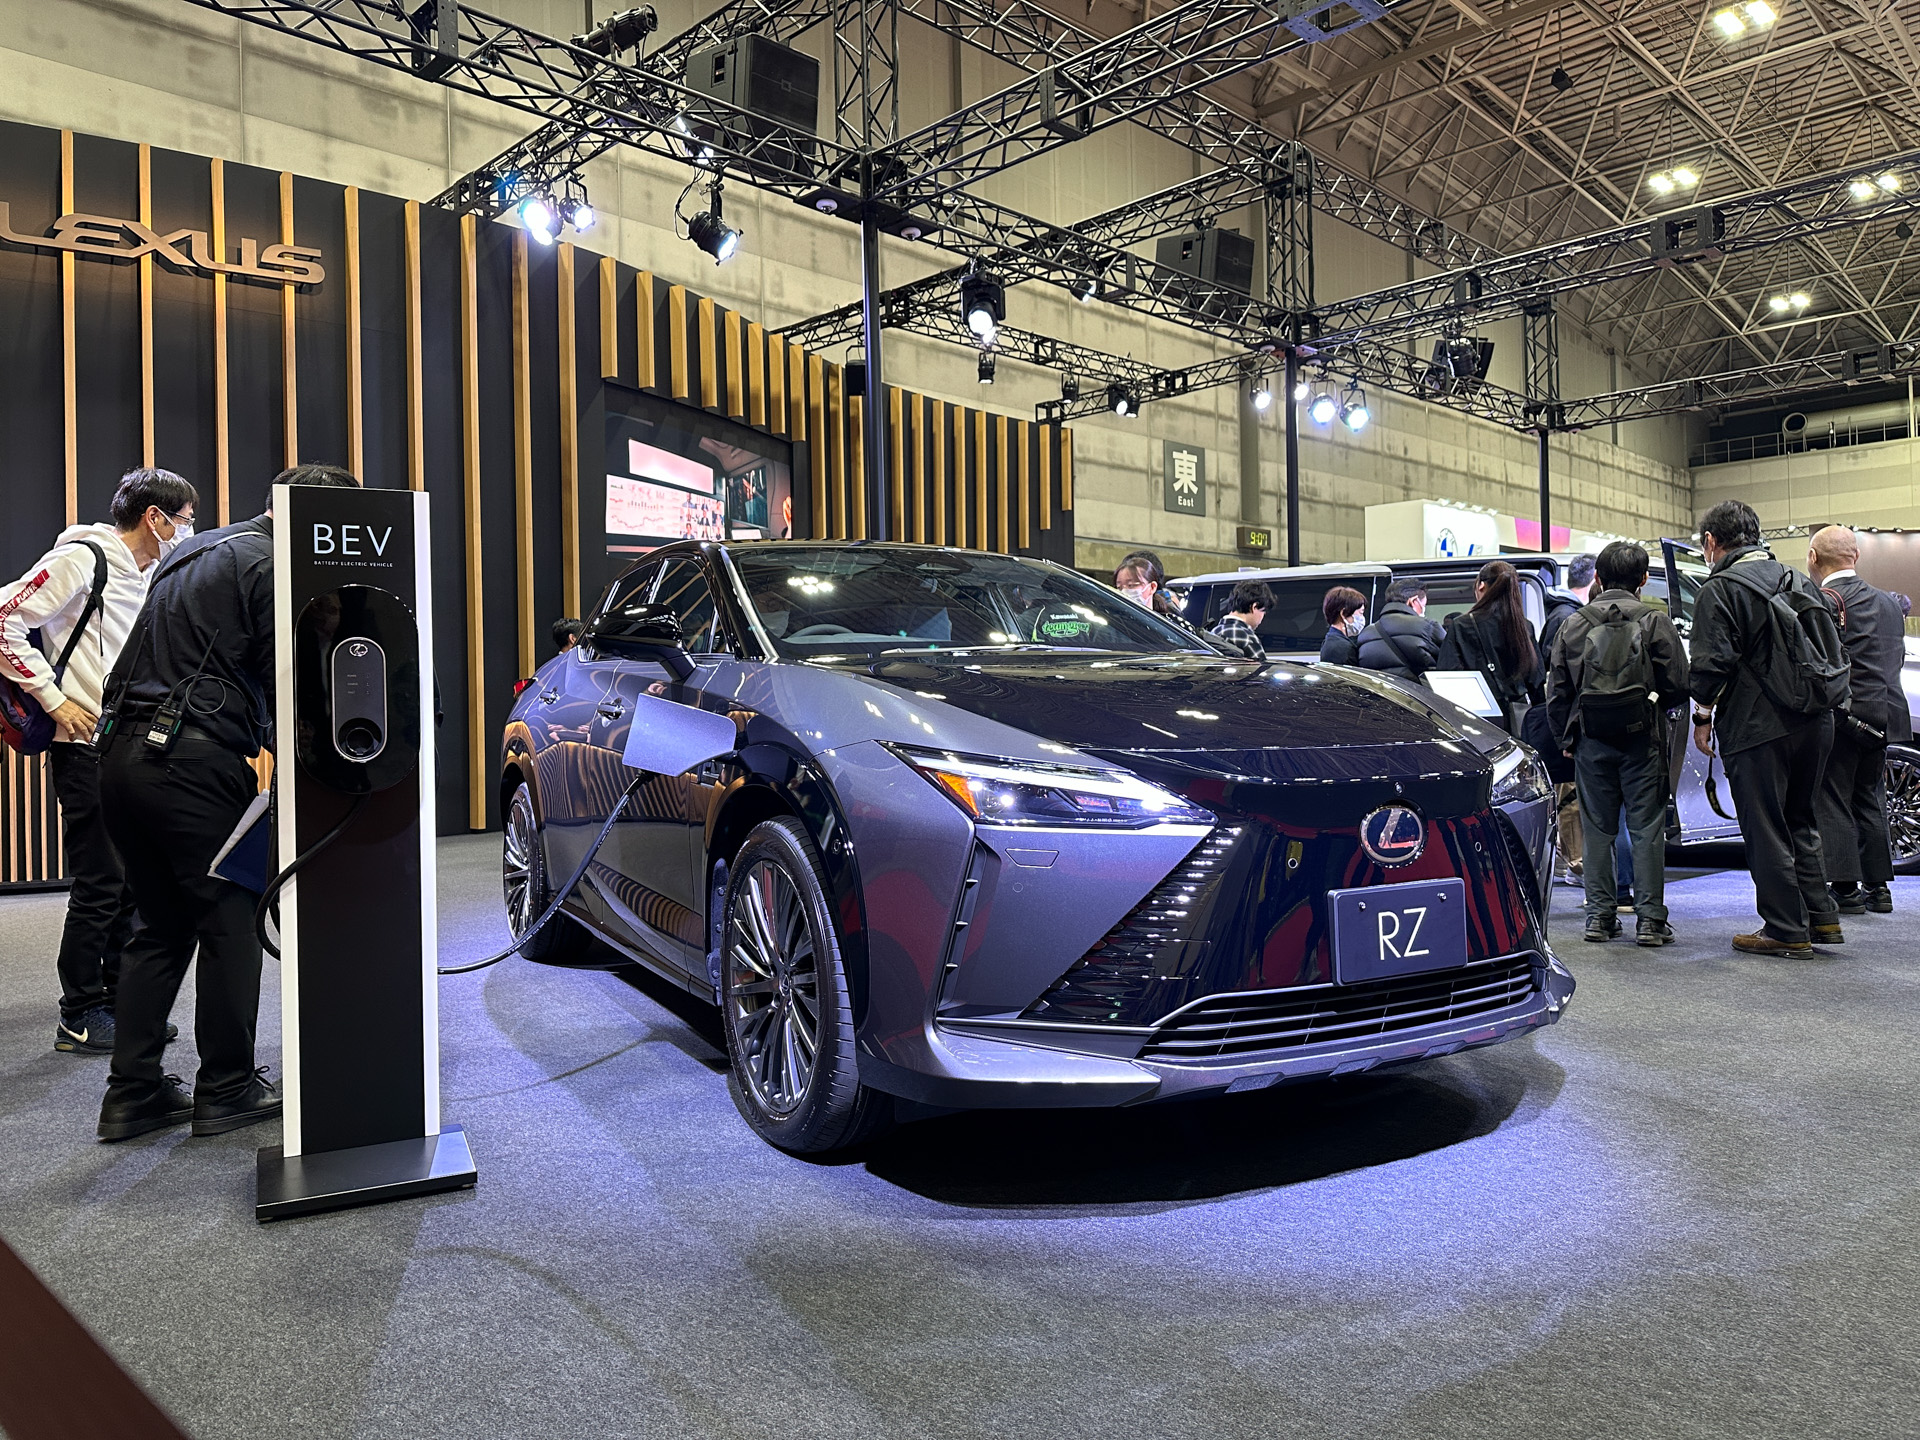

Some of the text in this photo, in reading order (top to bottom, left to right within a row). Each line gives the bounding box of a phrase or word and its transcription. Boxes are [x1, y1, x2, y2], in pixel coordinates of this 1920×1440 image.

[0, 201, 325, 285] LEXUS
[1172, 450, 1198, 494] 東
[1178, 496, 1194, 507] East
[313, 523, 393, 557] BEV
[1250, 531, 1268, 547] 9:07
[16, 583, 38, 604] PLAYER
[1378, 906, 1430, 960] RZ
